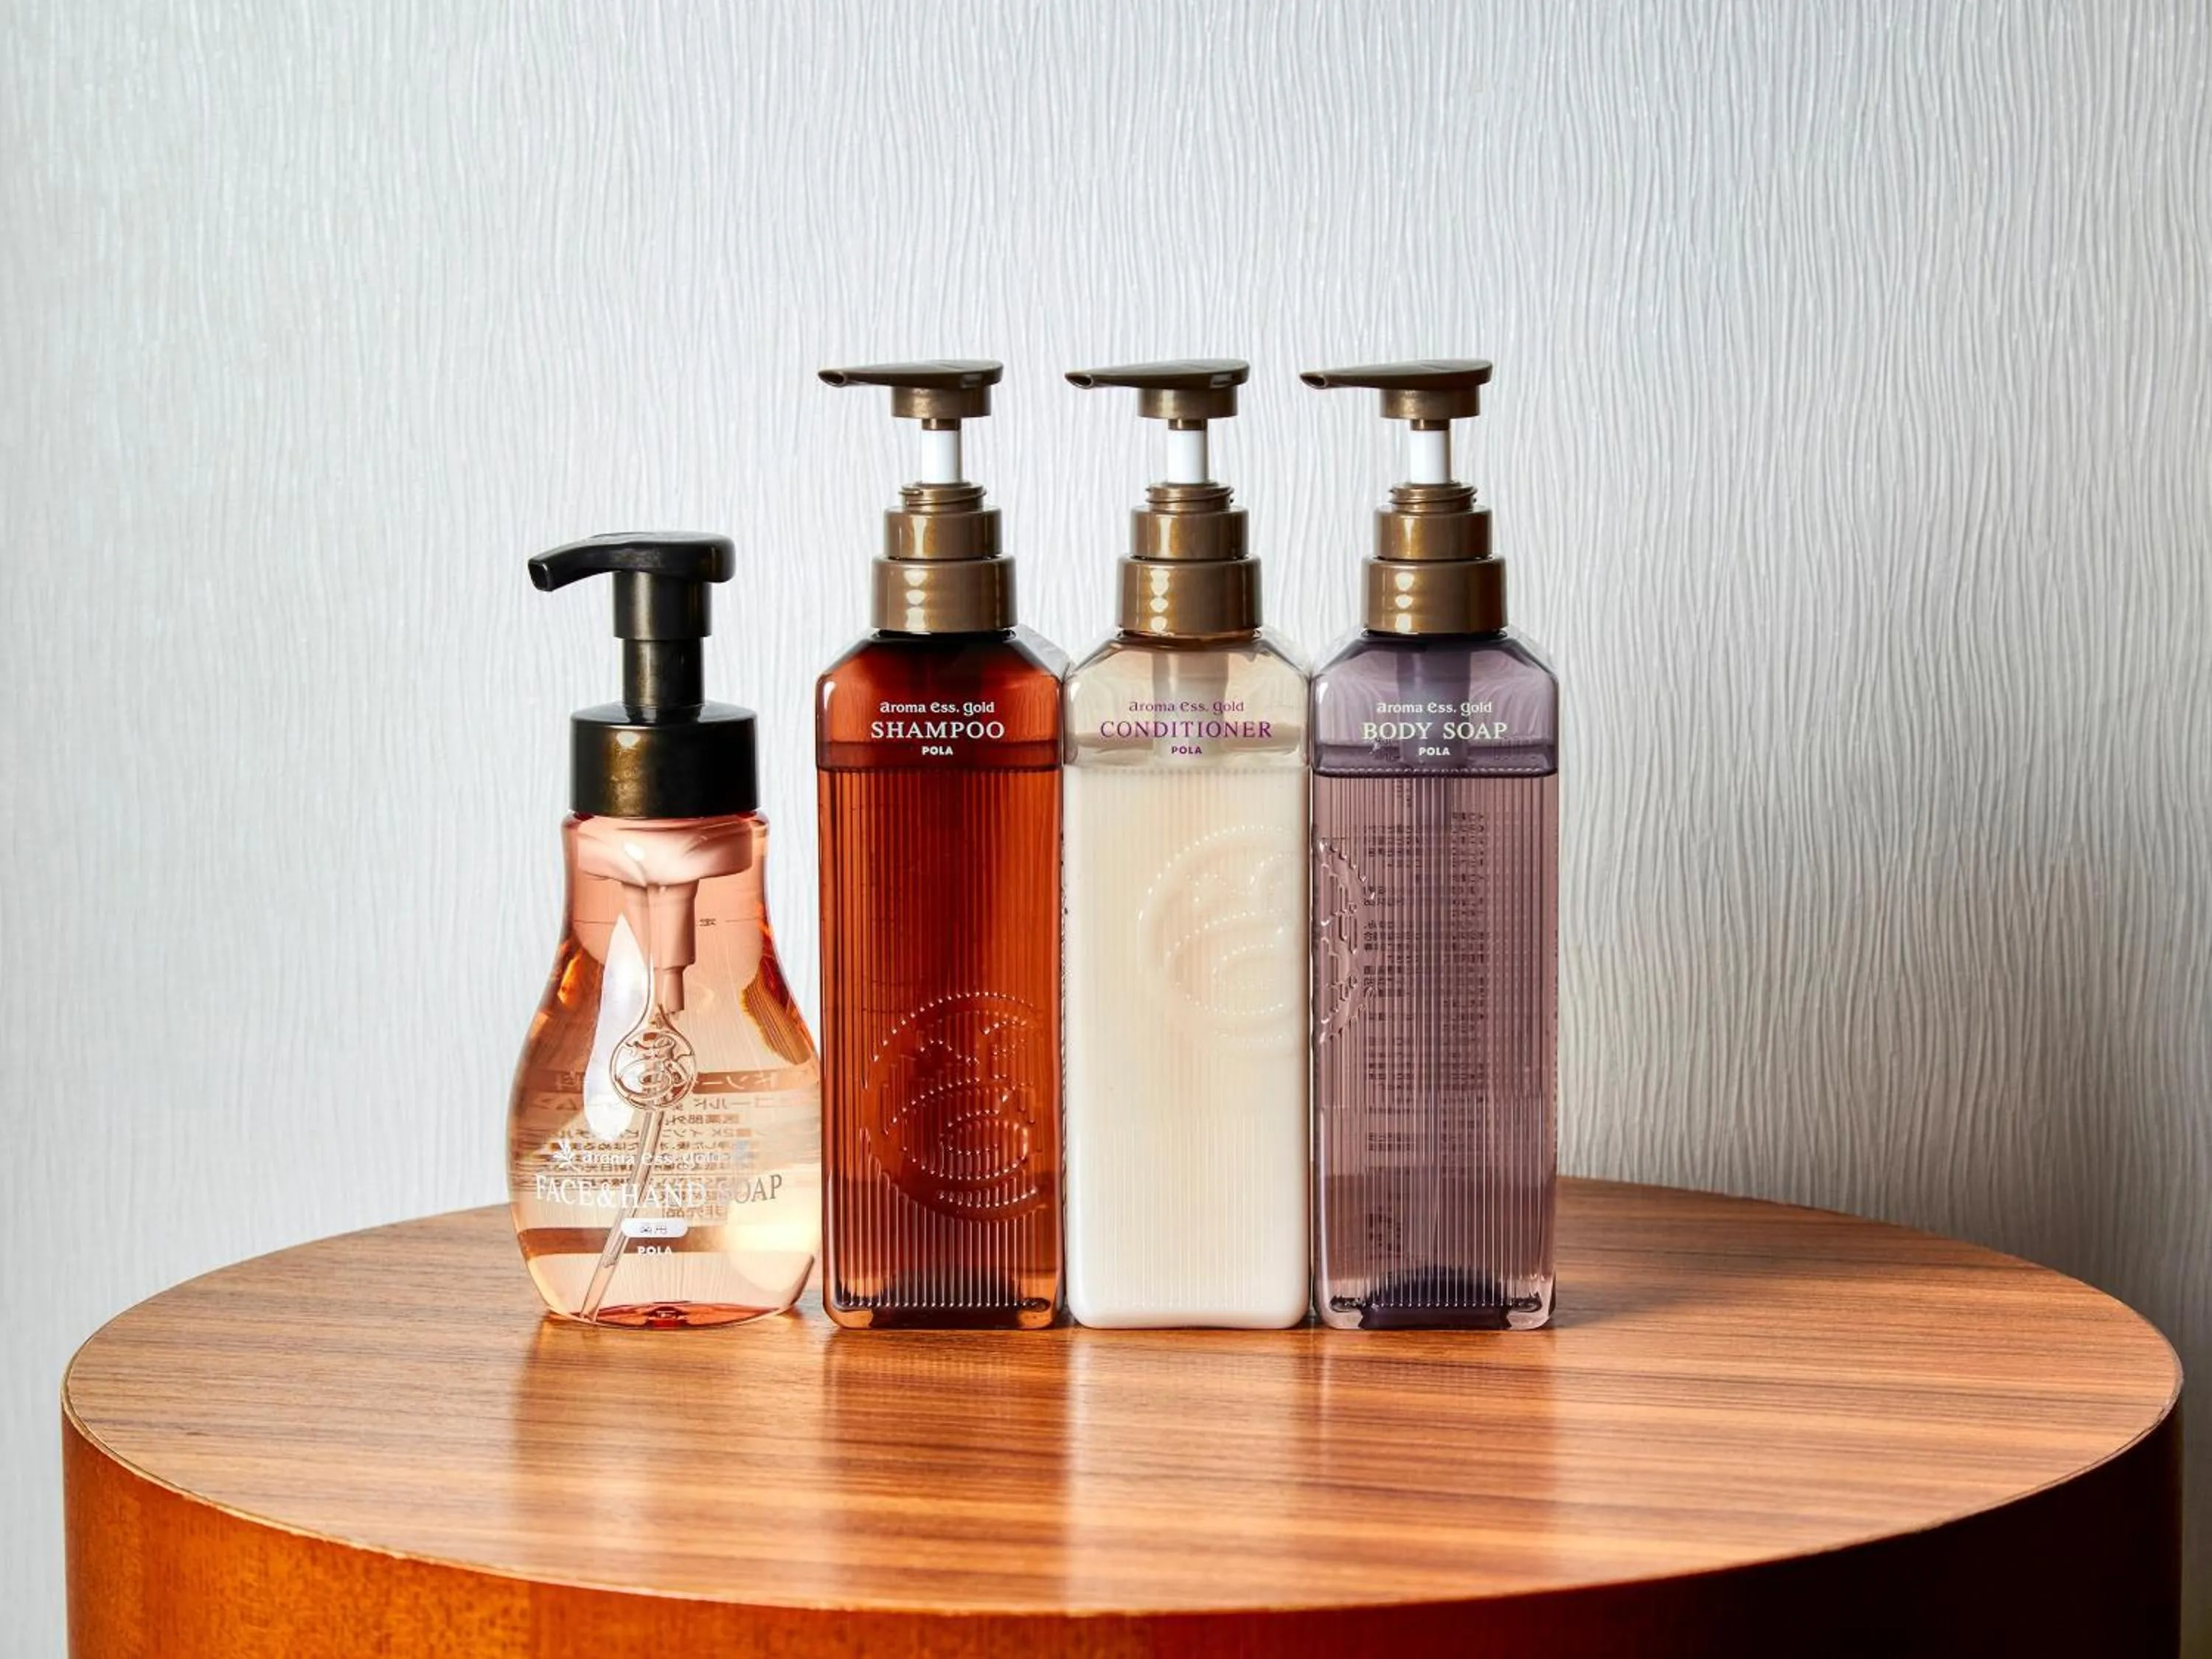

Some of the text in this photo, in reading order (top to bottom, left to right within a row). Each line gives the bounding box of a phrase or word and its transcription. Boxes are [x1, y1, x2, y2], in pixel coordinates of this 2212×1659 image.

[880, 701, 995, 716] aroma ess. gold
[1129, 701, 1244, 715] aroma ess. gold
[1377, 701, 1492, 716] aroma ess. gold
[871, 721, 1005, 739] SHAMPOO
[1100, 720, 1273, 738] CONDITIONER
[1363, 722, 1508, 740] BODY SOAP
[922, 745, 953, 756] POLA
[1171, 745, 1203, 755] POLA
[1419, 747, 1450, 757] POLA
[582, 1152, 634, 1165] aroma
[717, 1174, 782, 1204] SOAP
[637, 1246, 672, 1255] POLA
